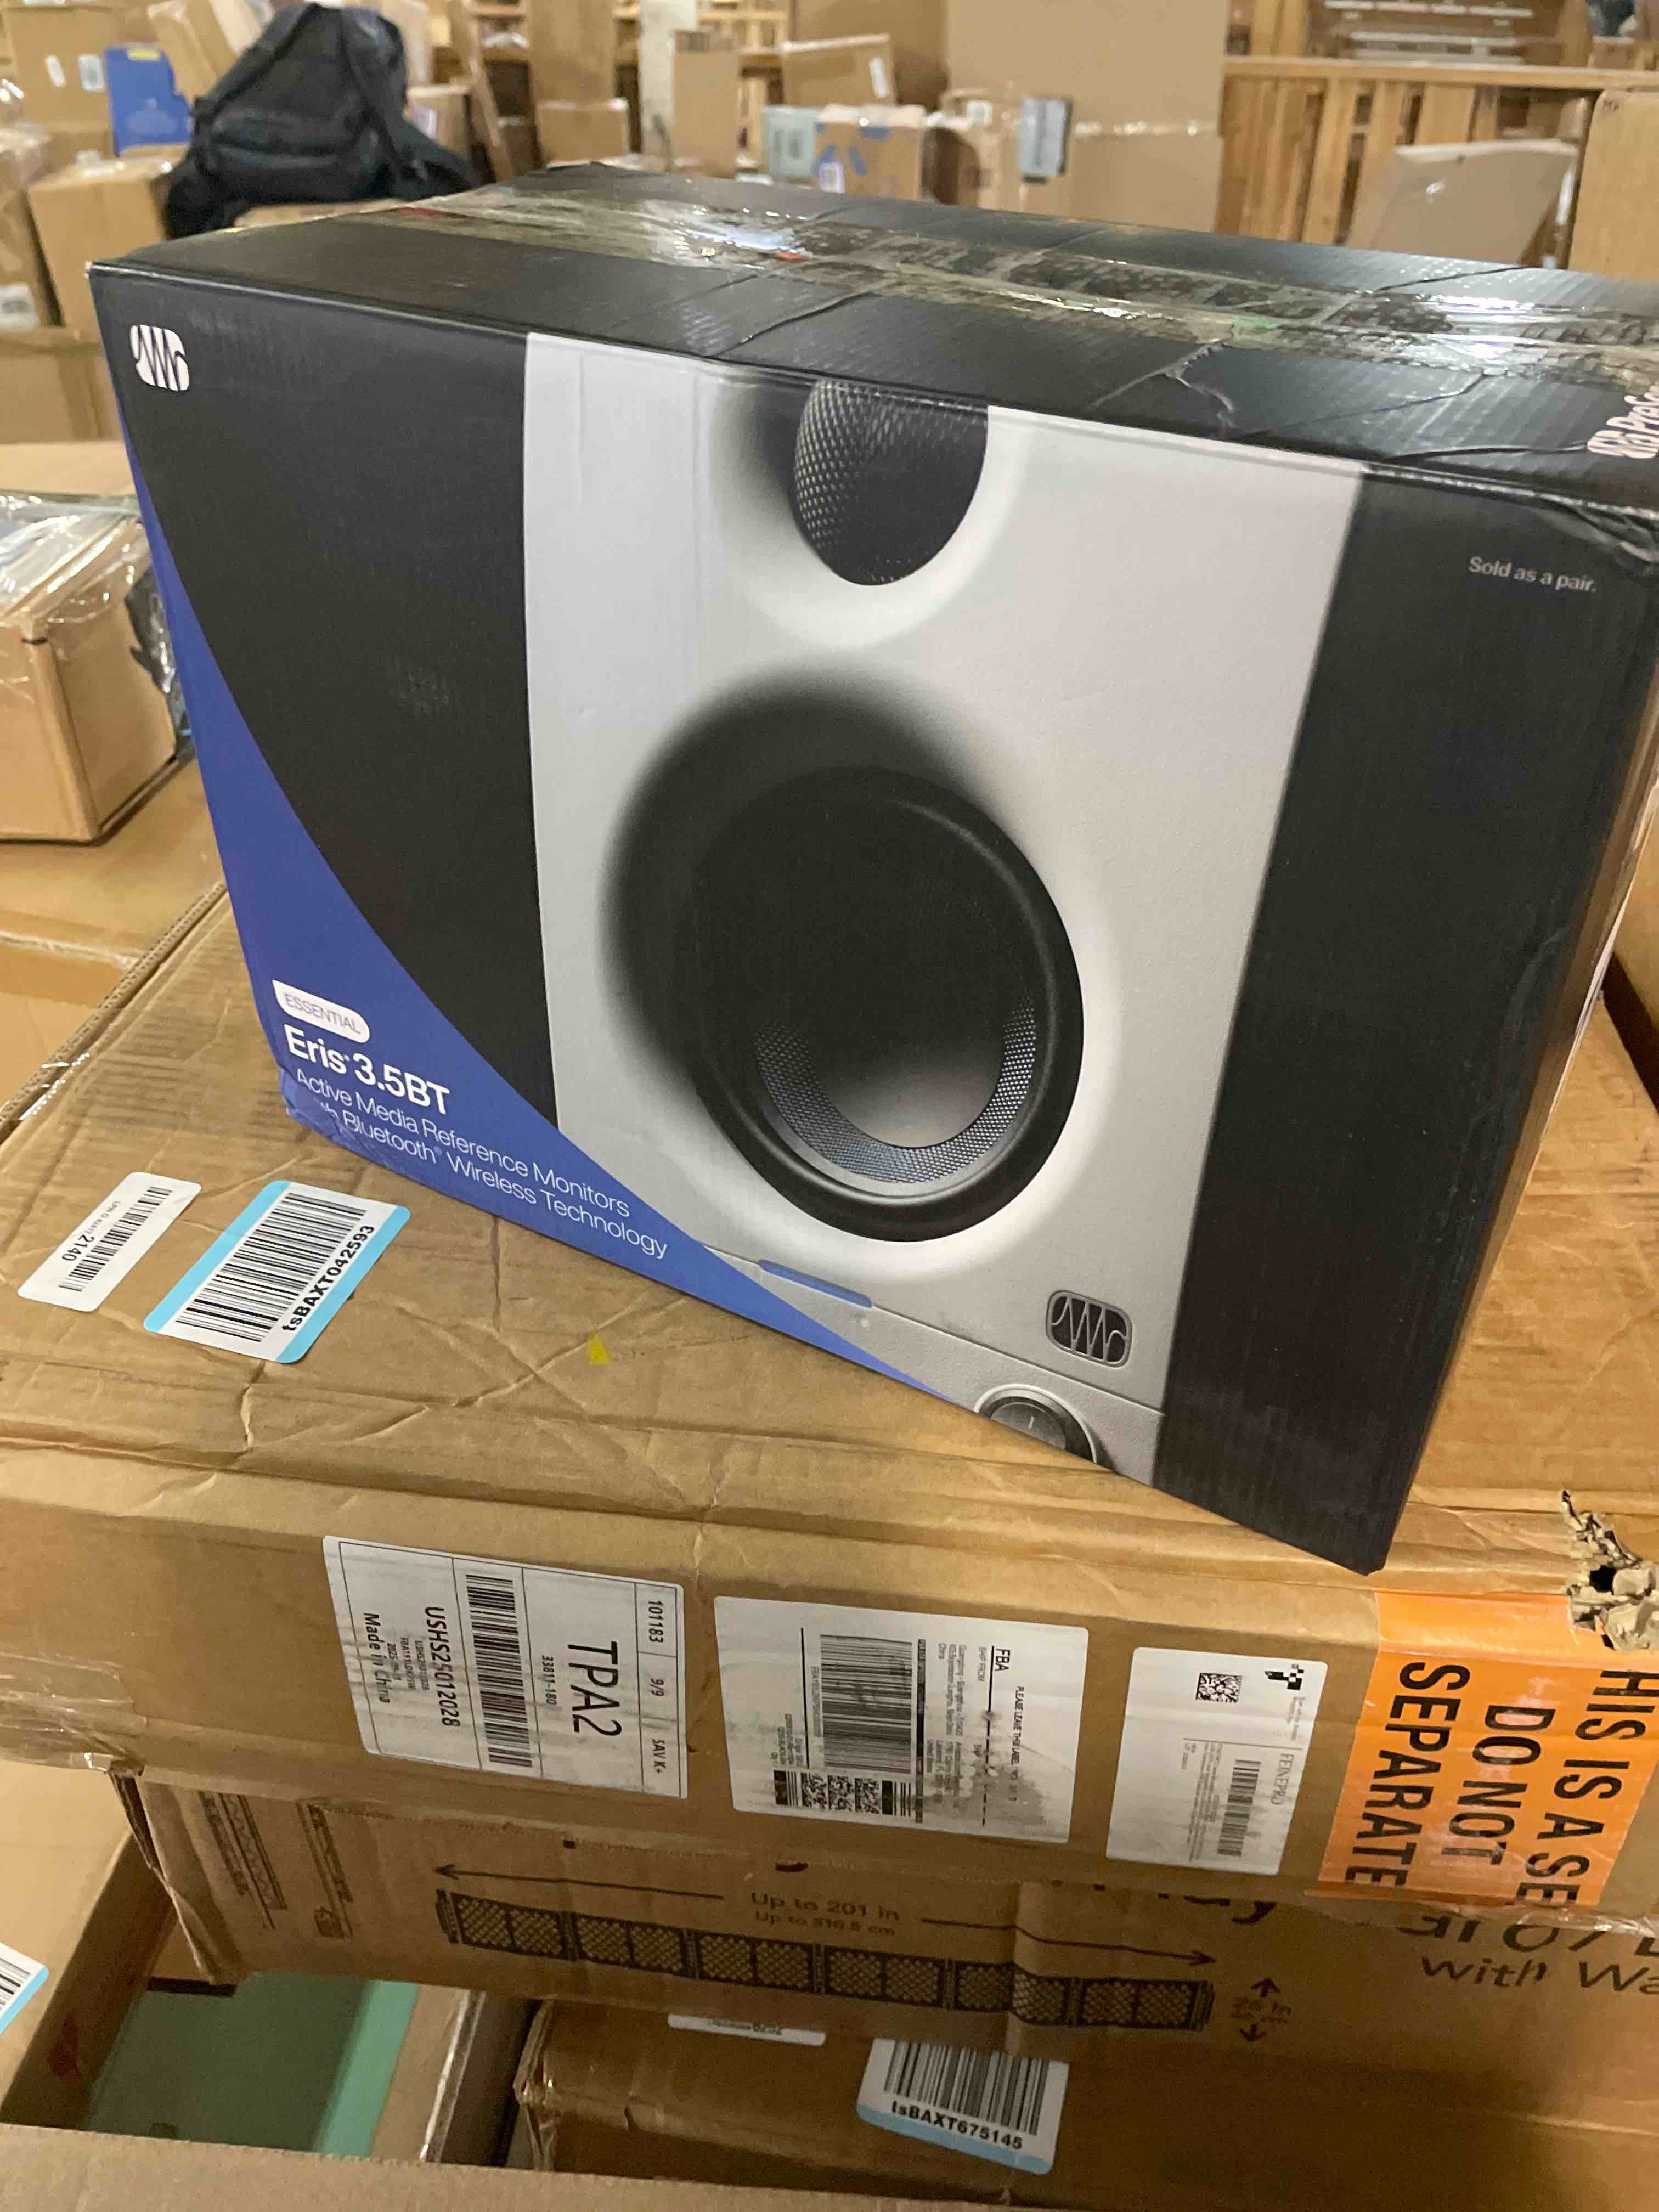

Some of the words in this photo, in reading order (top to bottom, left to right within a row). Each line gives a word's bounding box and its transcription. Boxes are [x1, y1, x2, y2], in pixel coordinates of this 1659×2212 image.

[1469, 556, 1511, 577] Sold
[1514, 568, 1536, 582] as
[1541, 572, 1553, 585] a
[1555, 575, 1596, 592] pair.
[285, 994, 362, 1035] ESSENTIAL
[353, 1053, 450, 1115] 3.5BT
[297, 1068, 353, 1107] Active
[356, 1091, 420, 1135] Media
[422, 1118, 529, 1177] Reference
[534, 1163, 630, 1217] Monitors
[447, 1152, 537, 1204] Wireless
[540, 1189, 668, 1260] Technology
[61, 1234, 95, 1261] 2140
[281, 1225, 375, 1331] tsBAXT042593
[363, 1612, 385, 1650] Made
[647, 1600, 664, 1643] 101183
[371, 1653, 387, 1666] in
[425, 1606, 461, 1727] USHS25012028
[995, 1647, 1011, 1672] FBA
[567, 1641, 622, 1737] TPA2
[650, 1678, 664, 1697] 9/9
[1014, 1686, 1025, 1711] PLEASE
[1575, 1634, 1659, 1740] HIS
[1472, 1705, 1556, 1765] DO
[1345, 1661, 1471, 1887] SEPARATE
[1554, 1759, 1630, 1799] IS
[1442, 1780, 1528, 1865] NOT
[1537, 1813, 1604, 1841] A
[1515, 1852, 1590, 1907] SE
[752, 1893, 785, 1910] Up
[795, 1898, 818, 1911] to
[827, 1900, 867, 1917] 201
[1422, 1957, 1547, 1988] with
